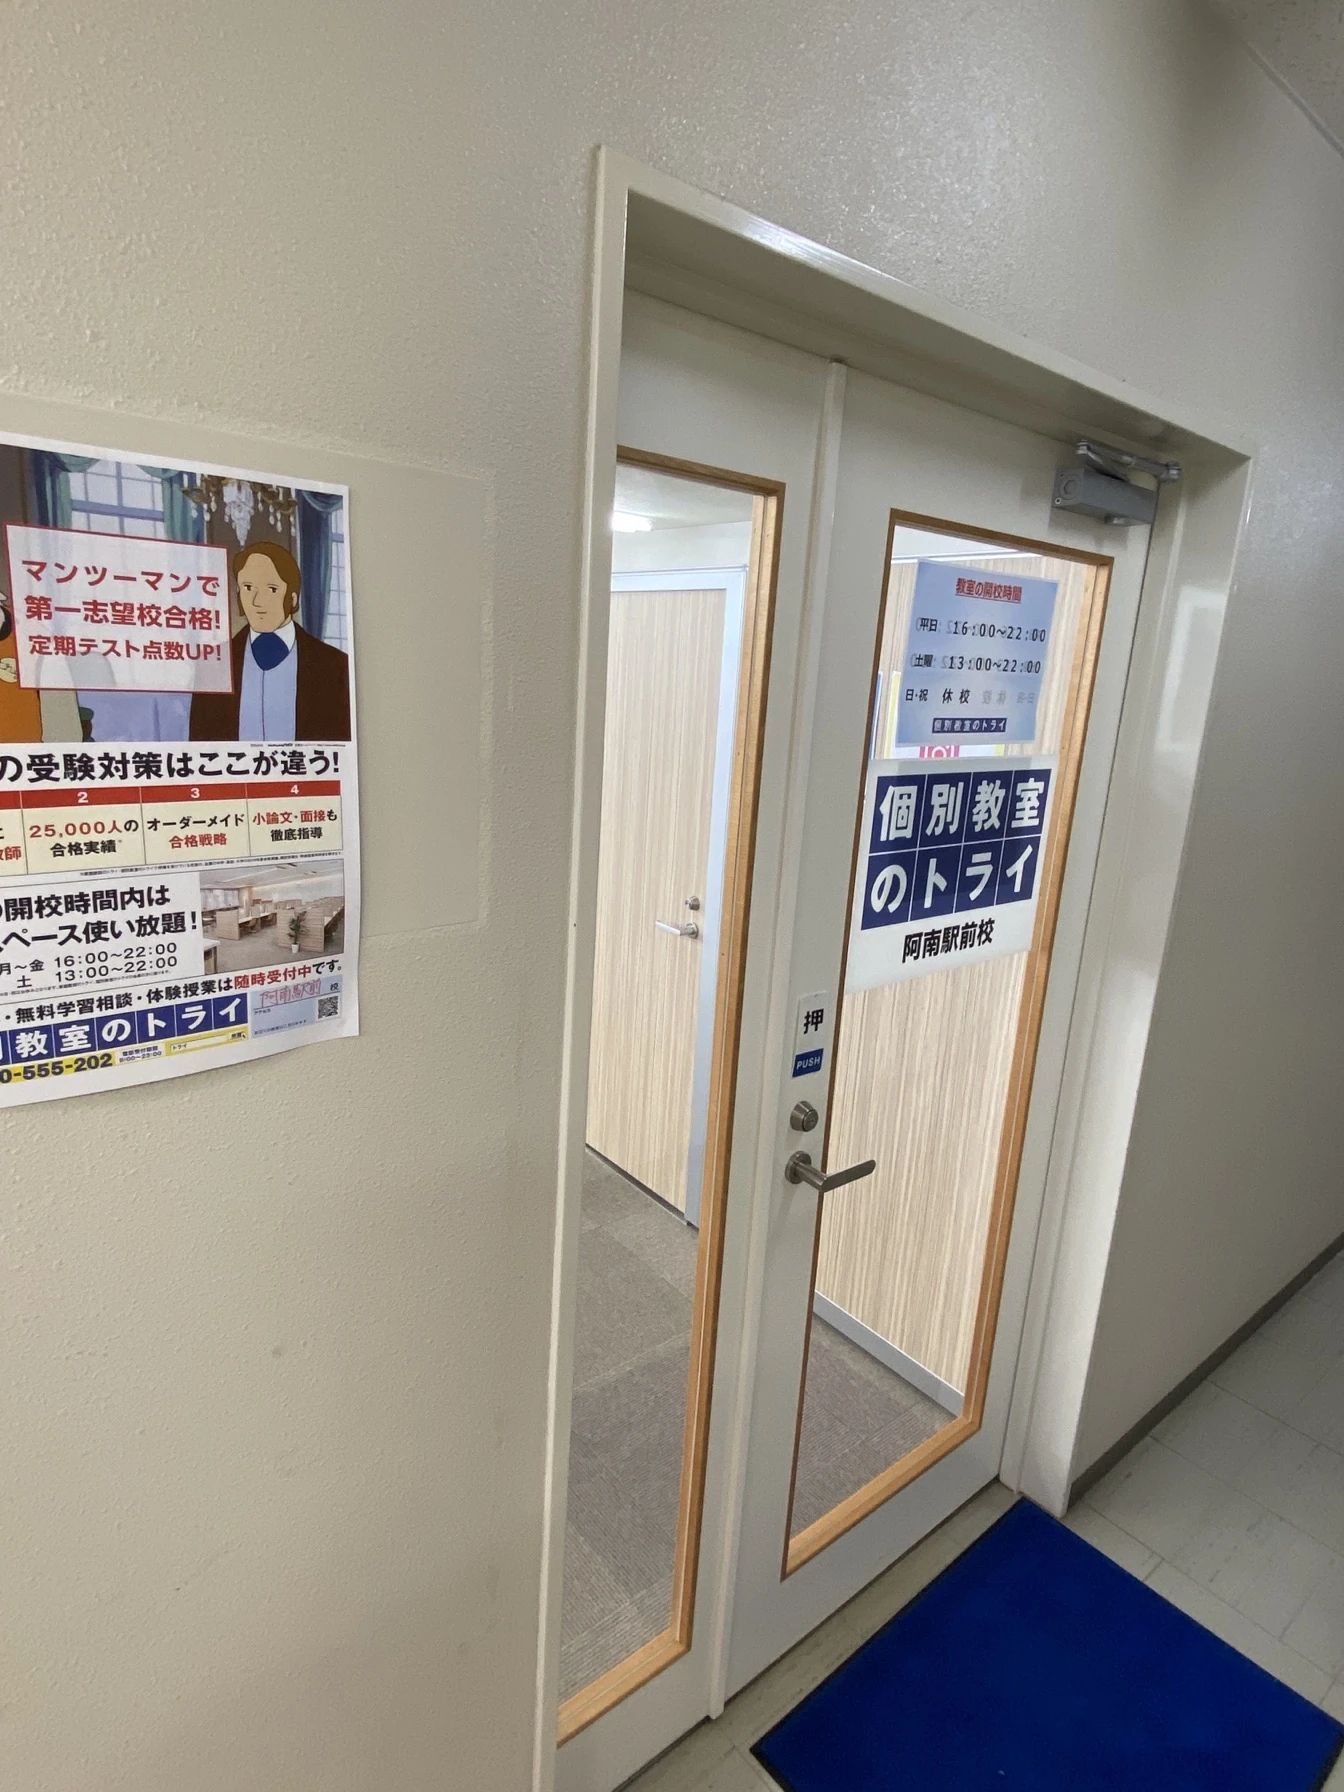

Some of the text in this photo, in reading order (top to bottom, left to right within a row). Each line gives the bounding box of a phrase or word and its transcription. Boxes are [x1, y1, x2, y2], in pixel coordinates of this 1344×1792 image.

[21, 559, 220, 597] マンツーマンで
[955, 577, 1023, 604] 教室の開校時間
[77, 791, 89, 804] 2
[190, 787, 201, 799] 3
[290, 784, 300, 795] 4
[252, 808, 338, 826] 小論文・面接も
[879, 776, 1046, 844] 個別教室
[29, 818, 139, 839] 25,000人の
[147, 813, 245, 832] オーダーメイド
[168, 832, 228, 849] 合格戦略
[270, 826, 324, 842] 徹底指導
[870, 843, 1037, 914] のトライ
[0, 884, 171, 922] 開校時間内は
[901, 917, 996, 964] 阿南駅前校
[17, 975, 33, 988] 土
[0, 996, 242, 1061] 教室のトライ
[803, 1008, 825, 1035] 押
[796, 1055, 821, 1071] PUSH
